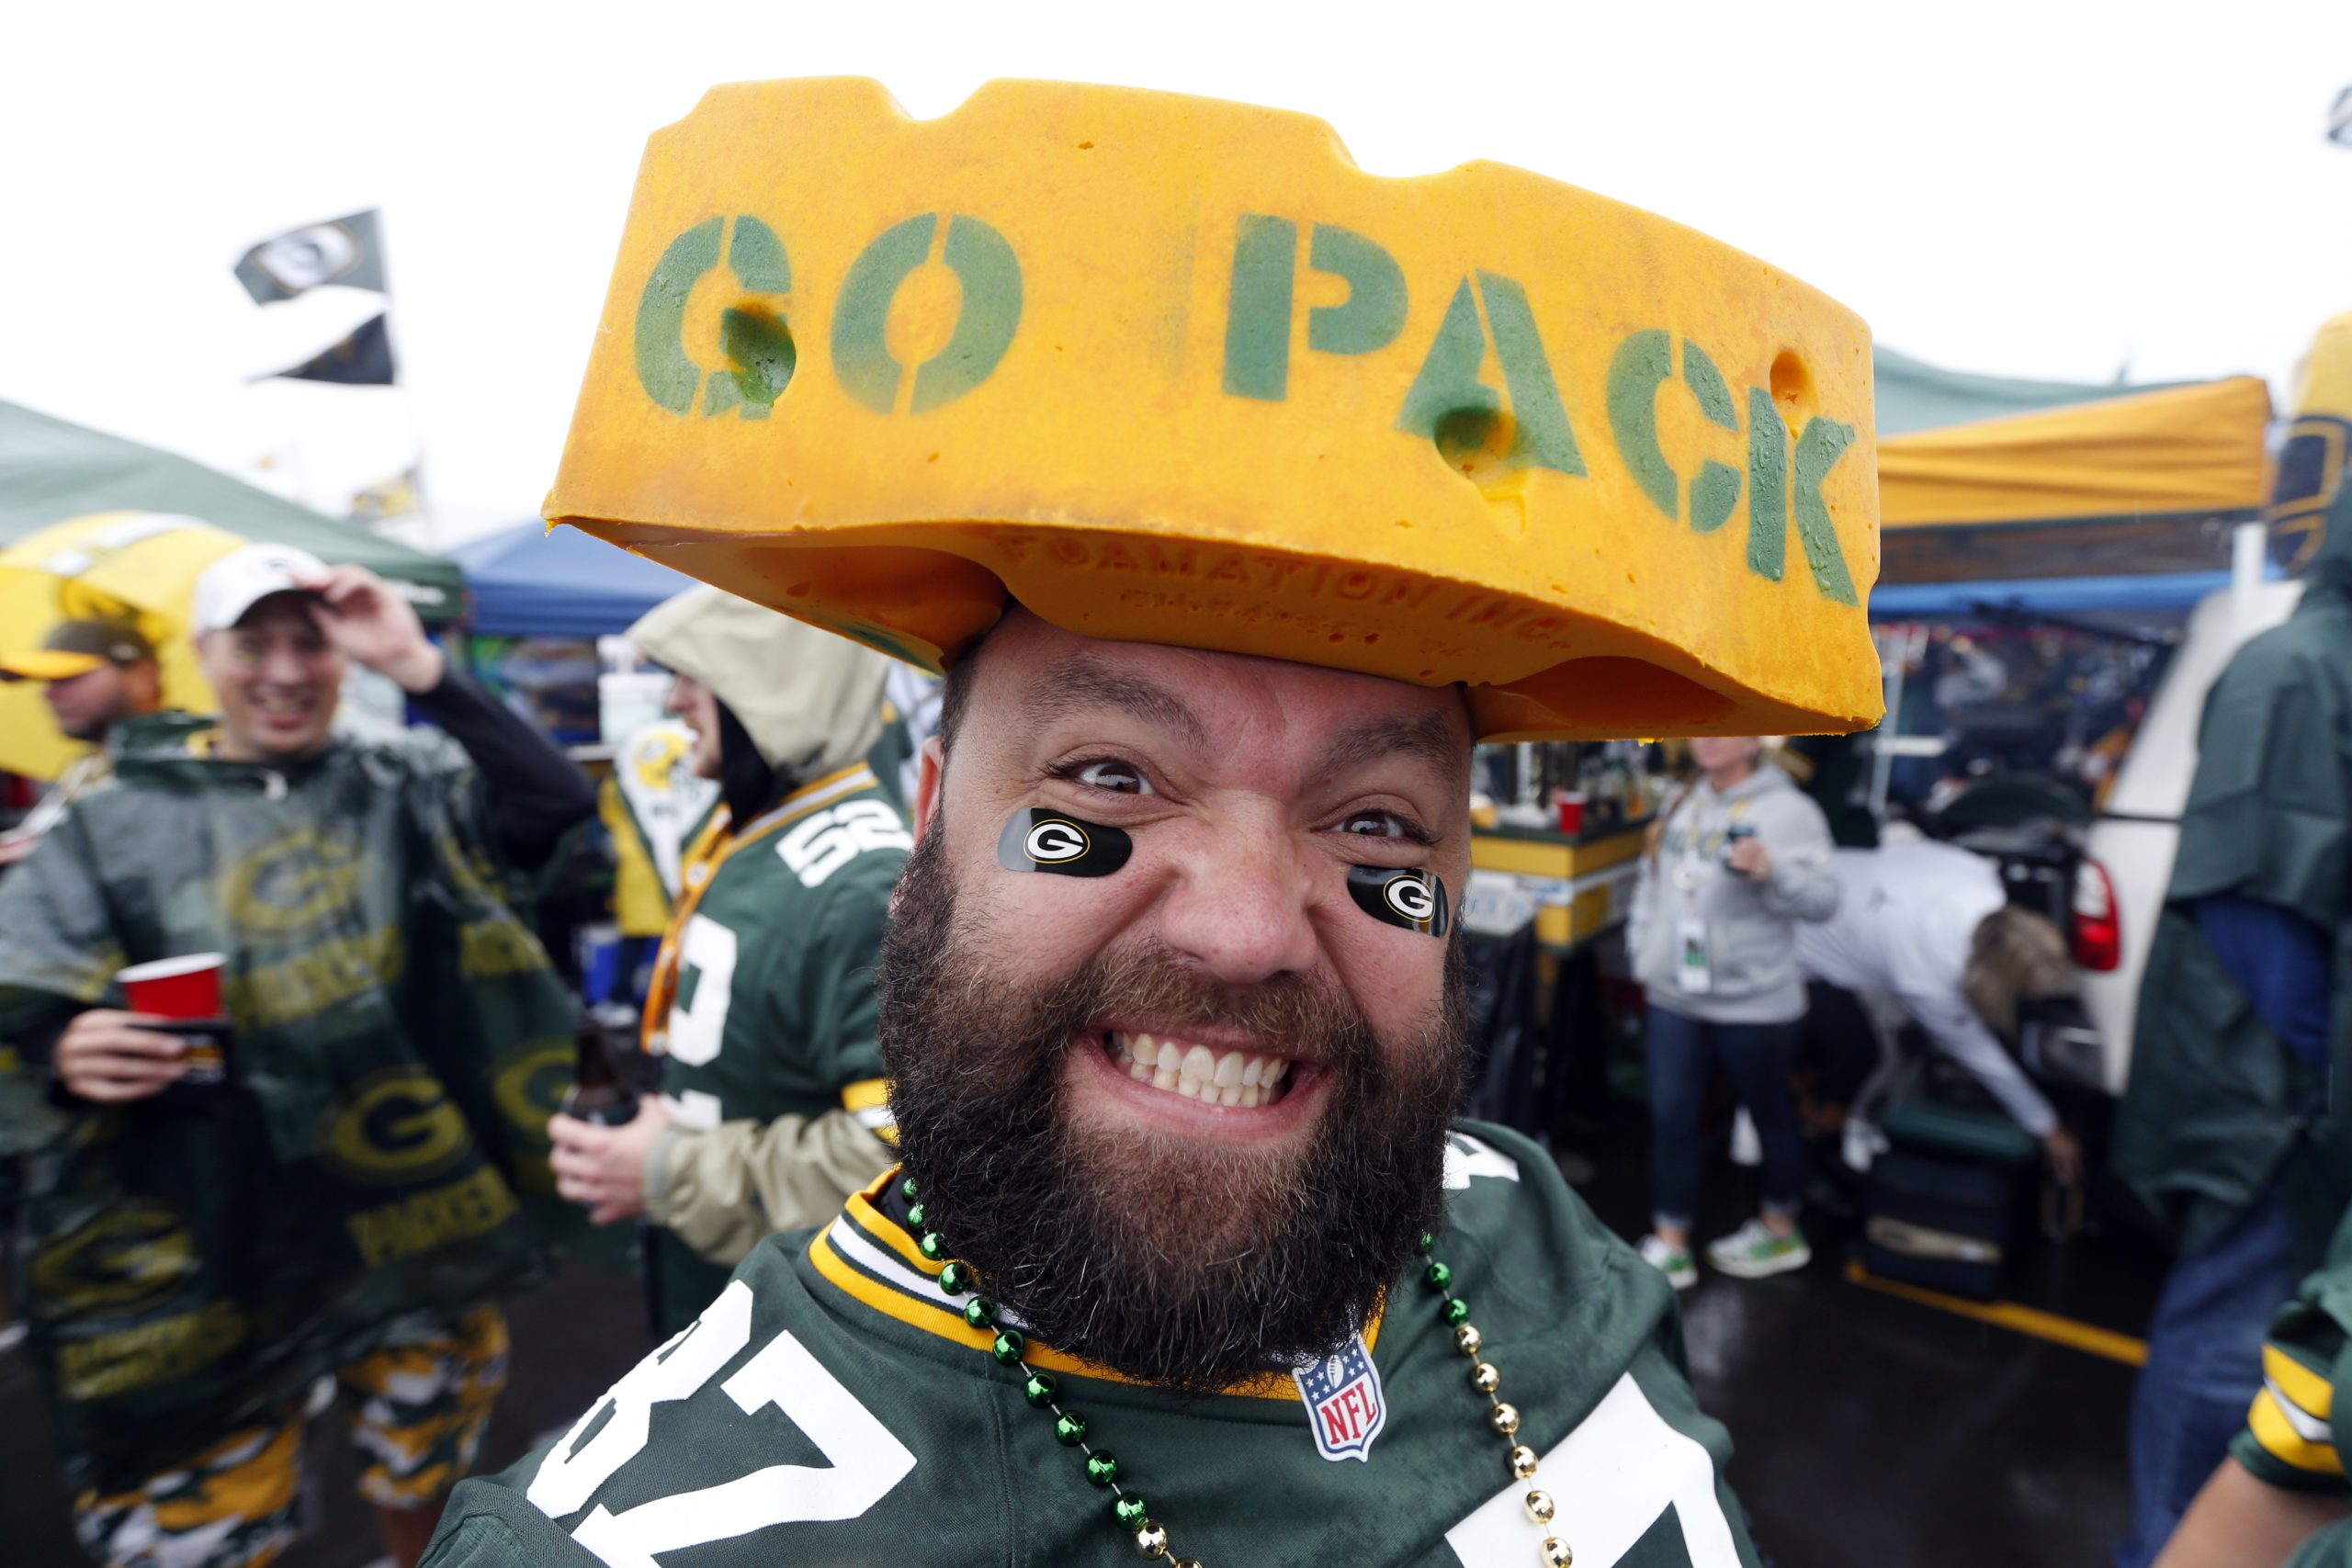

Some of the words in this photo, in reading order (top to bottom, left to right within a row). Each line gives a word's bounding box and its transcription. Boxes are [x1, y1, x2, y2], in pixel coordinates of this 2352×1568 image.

[634, 212, 1024, 421] GO
[1222, 213, 1861, 607] PACK
[774, 799, 913, 888] 52
[526, 1280, 918, 1568] 87
[1320, 1382, 1377, 1445] NFL
